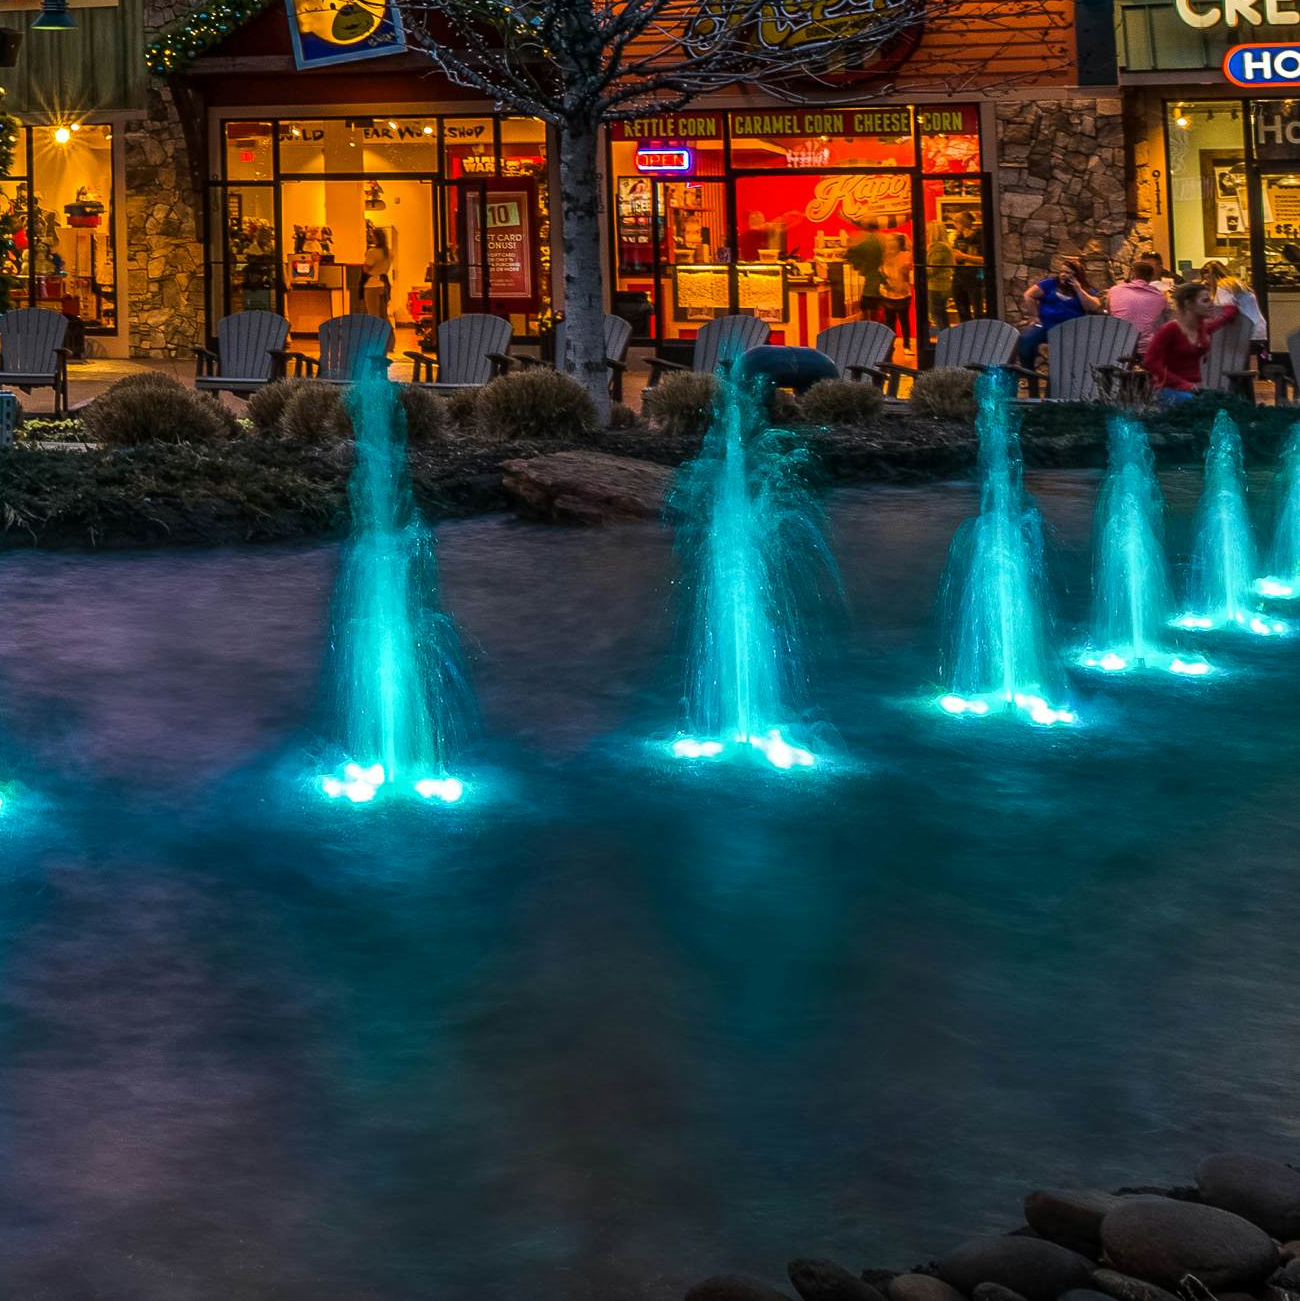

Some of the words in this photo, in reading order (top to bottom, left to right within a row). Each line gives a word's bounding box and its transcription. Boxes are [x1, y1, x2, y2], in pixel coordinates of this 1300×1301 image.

[1243, 49, 1300, 81] HO
[623, 118, 675, 138] KETTLE
[678, 117, 716, 137] CORN
[735, 114, 801, 135] CARAMEL
[804, 114, 844, 133] CORN
[853, 112, 909, 133] CHEESE
[923, 111, 963, 131] CORN
[363, 127, 394, 139] EAR
[396, 125, 486, 140] WOSHOP
[635, 153, 685, 167] OPEN
[475, 233, 496, 242] GFT
[497, 233, 522, 242] CARD
[487, 241, 516, 250] ONUS!
